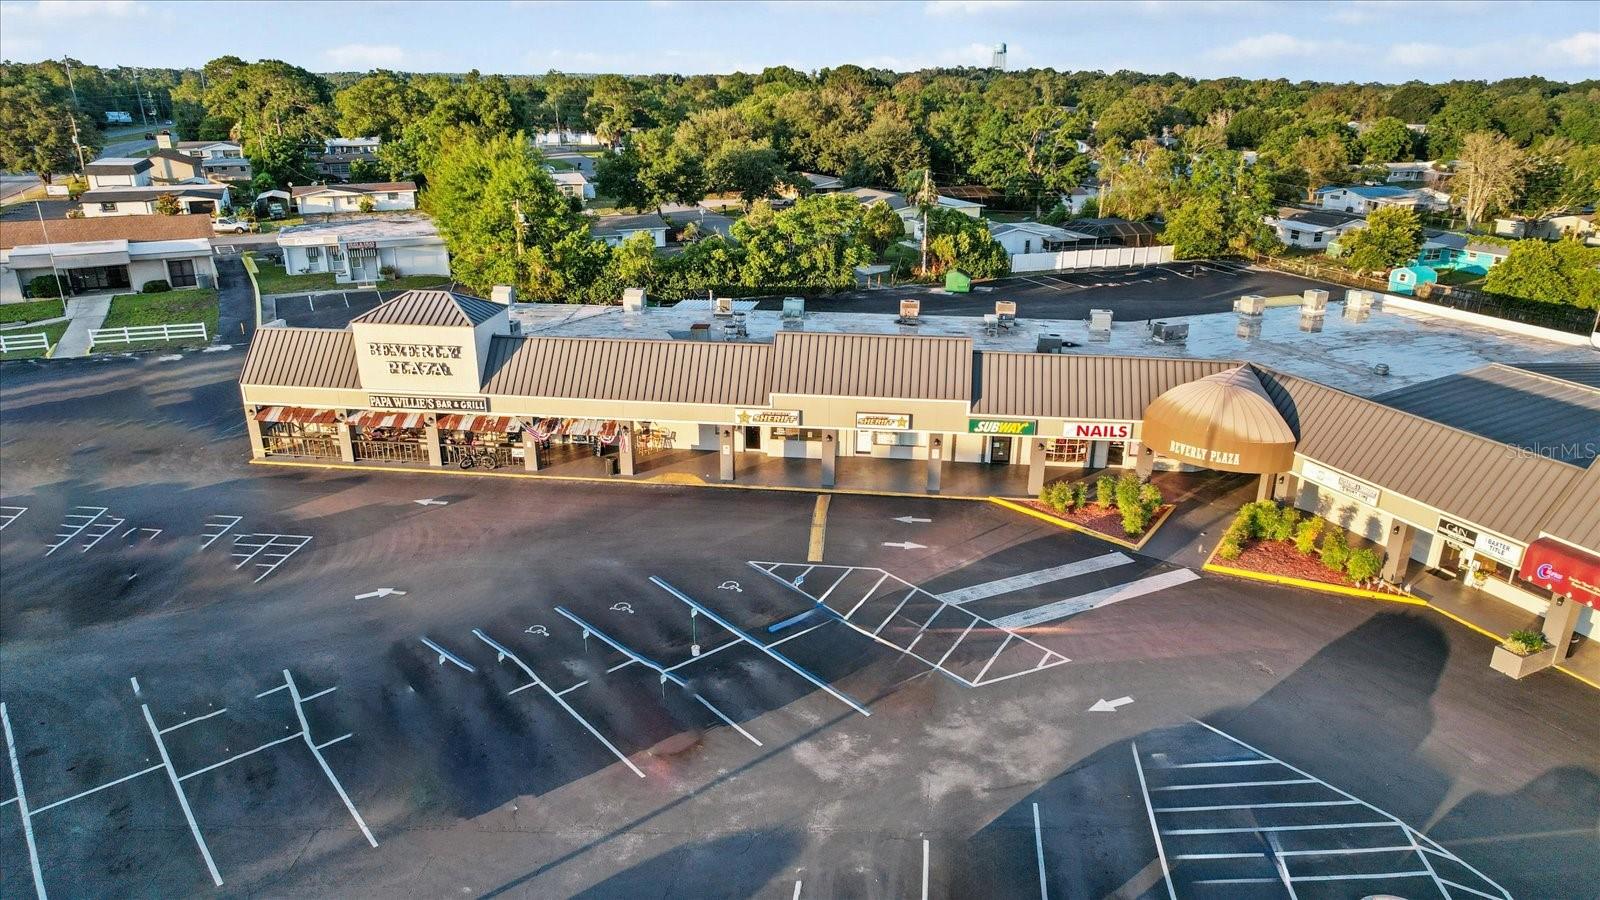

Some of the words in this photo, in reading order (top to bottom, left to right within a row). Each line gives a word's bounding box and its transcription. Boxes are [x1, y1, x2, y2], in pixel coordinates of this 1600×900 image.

[368, 342, 462, 359] BEVERLY
[386, 361, 453, 376] PLAZA
[369, 396, 393, 408] PAPA
[393, 397, 435, 409] WILLIE'S
[435, 400, 453, 409] BAR
[460, 401, 485, 410] GRILL
[753, 414, 798, 424] SHERIFF
[858, 417, 896, 426] SHERIFF
[974, 421, 1029, 434] SUBWAY
[1076, 425, 1128, 438] NAILS
[1169, 440, 1208, 460] BEVERLY
[1209, 450, 1240, 465] PLAZA
[1445, 523, 1469, 537] CAIN
[1487, 538, 1511, 552] BAXTER
[1488, 545, 1505, 556] TITLE
